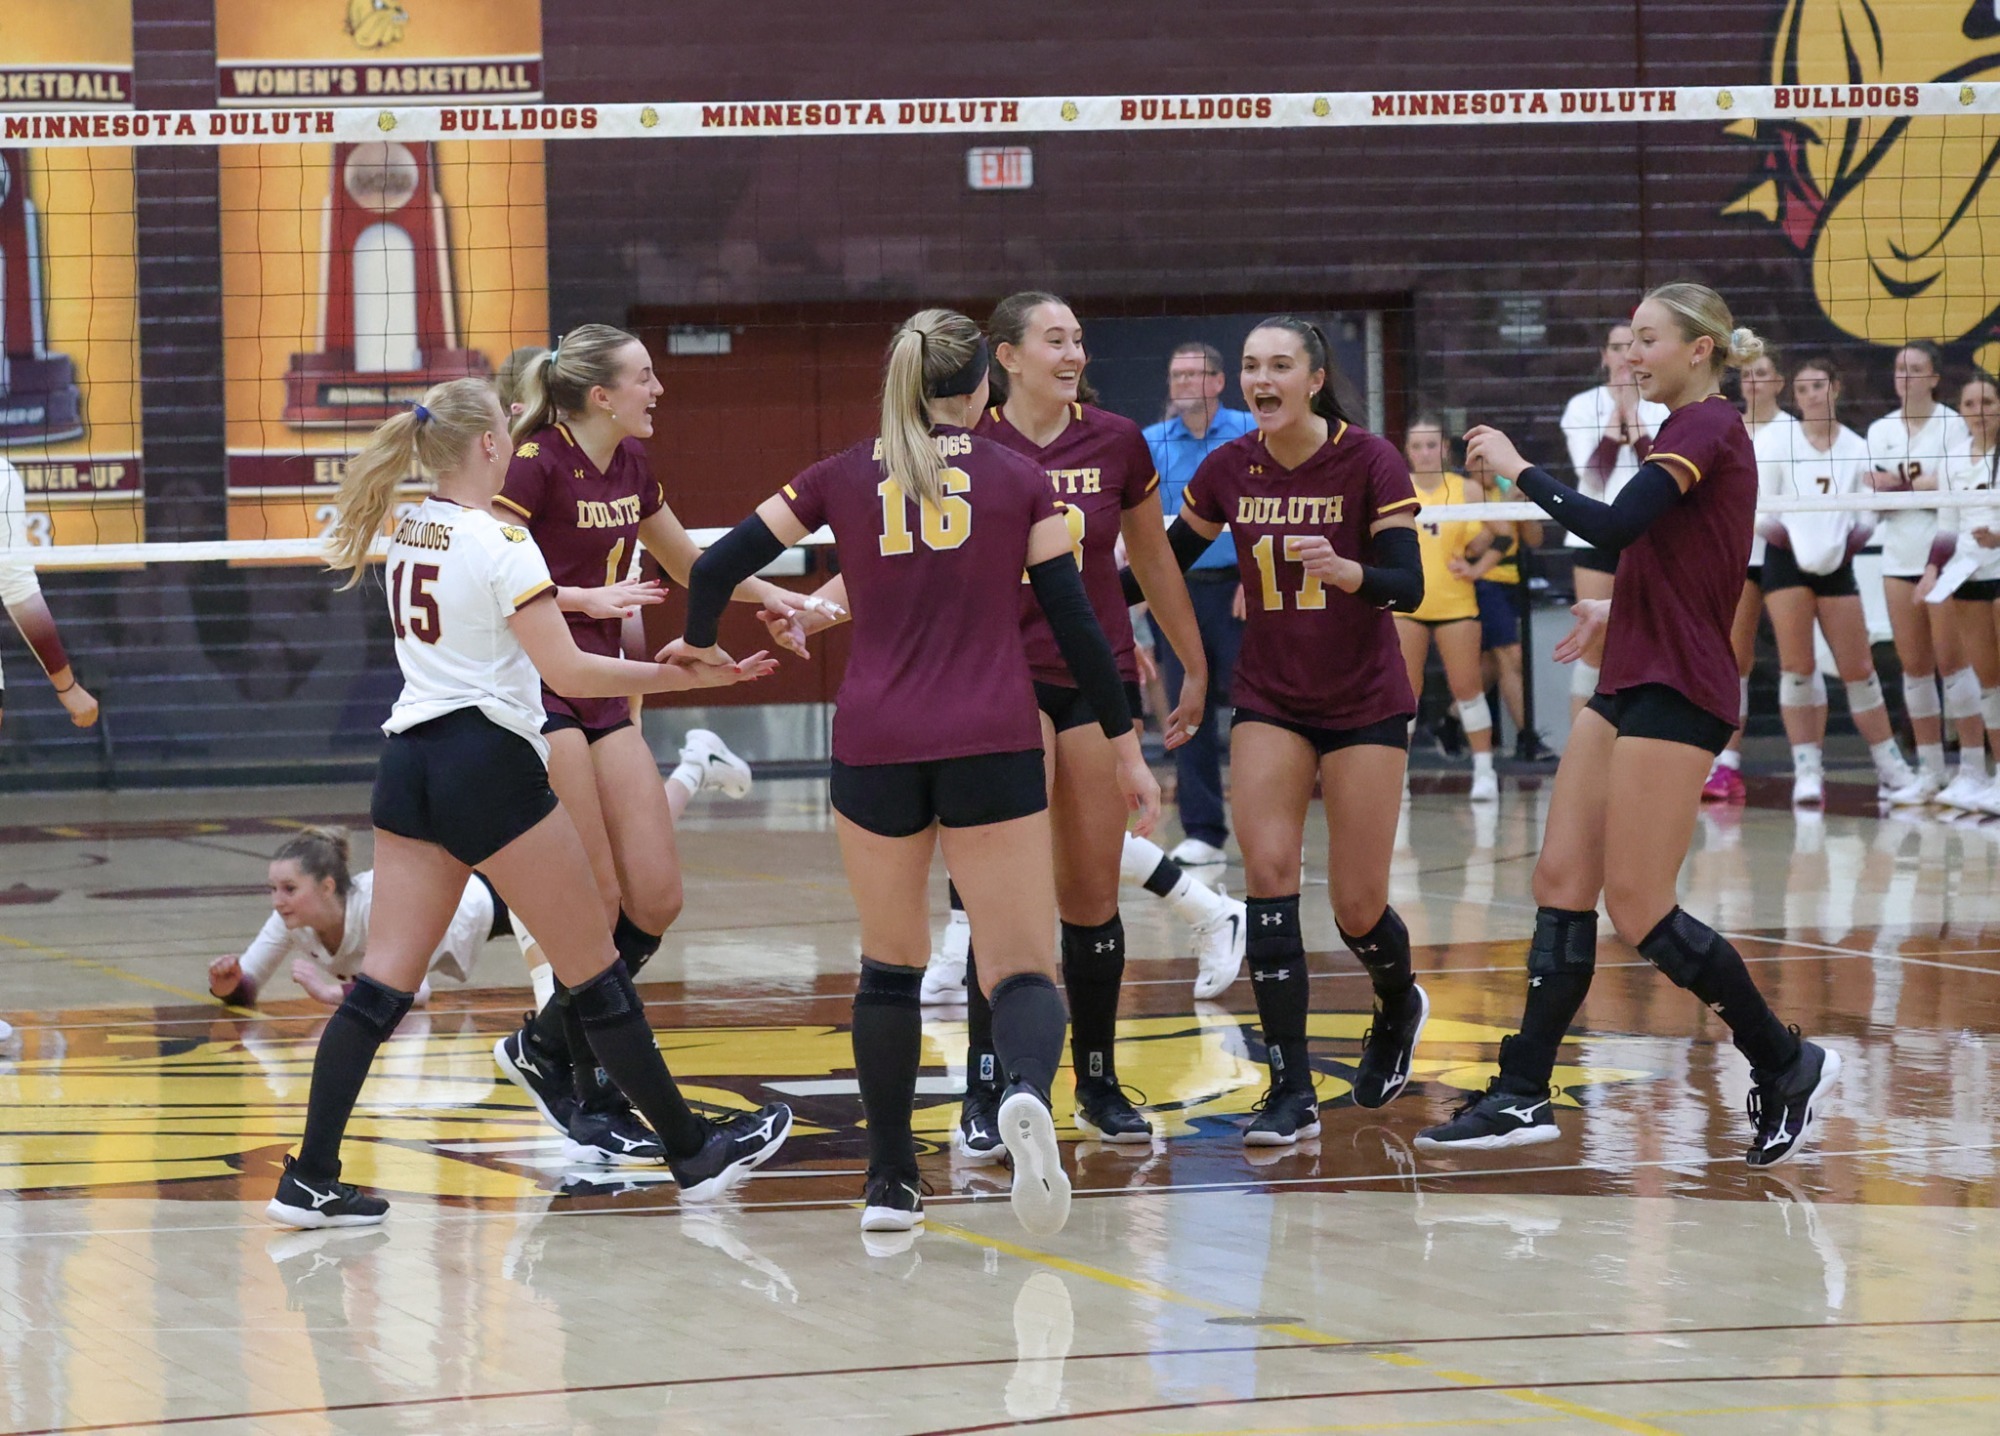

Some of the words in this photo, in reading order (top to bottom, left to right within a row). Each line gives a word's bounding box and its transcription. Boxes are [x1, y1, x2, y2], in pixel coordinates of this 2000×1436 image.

[233, 69, 357, 95] WOMEN'S
[366, 65, 532, 93] BASKETBALL
[1120, 97, 1272, 121] BULLDOGS
[1372, 91, 1549, 117] MINNESOTA
[1560, 89, 1677, 115] DULUTH
[1774, 85, 1919, 109] BULLDOGS
[4, 113, 196, 139] MINNESOTA
[209, 111, 335, 136] DULUTH
[440, 107, 598, 131] BULLDOGS
[702, 102, 886, 128] MINNESOTA
[898, 100, 1019, 125] DULUTH
[1816, 478, 1830, 494] 7
[877, 466, 971, 556] 16
[1236, 496, 1344, 524] DULUTH
[396, 518, 453, 551] BULLDOGS
[1252, 534, 1327, 611] 17
[391, 560, 442, 645] 15
